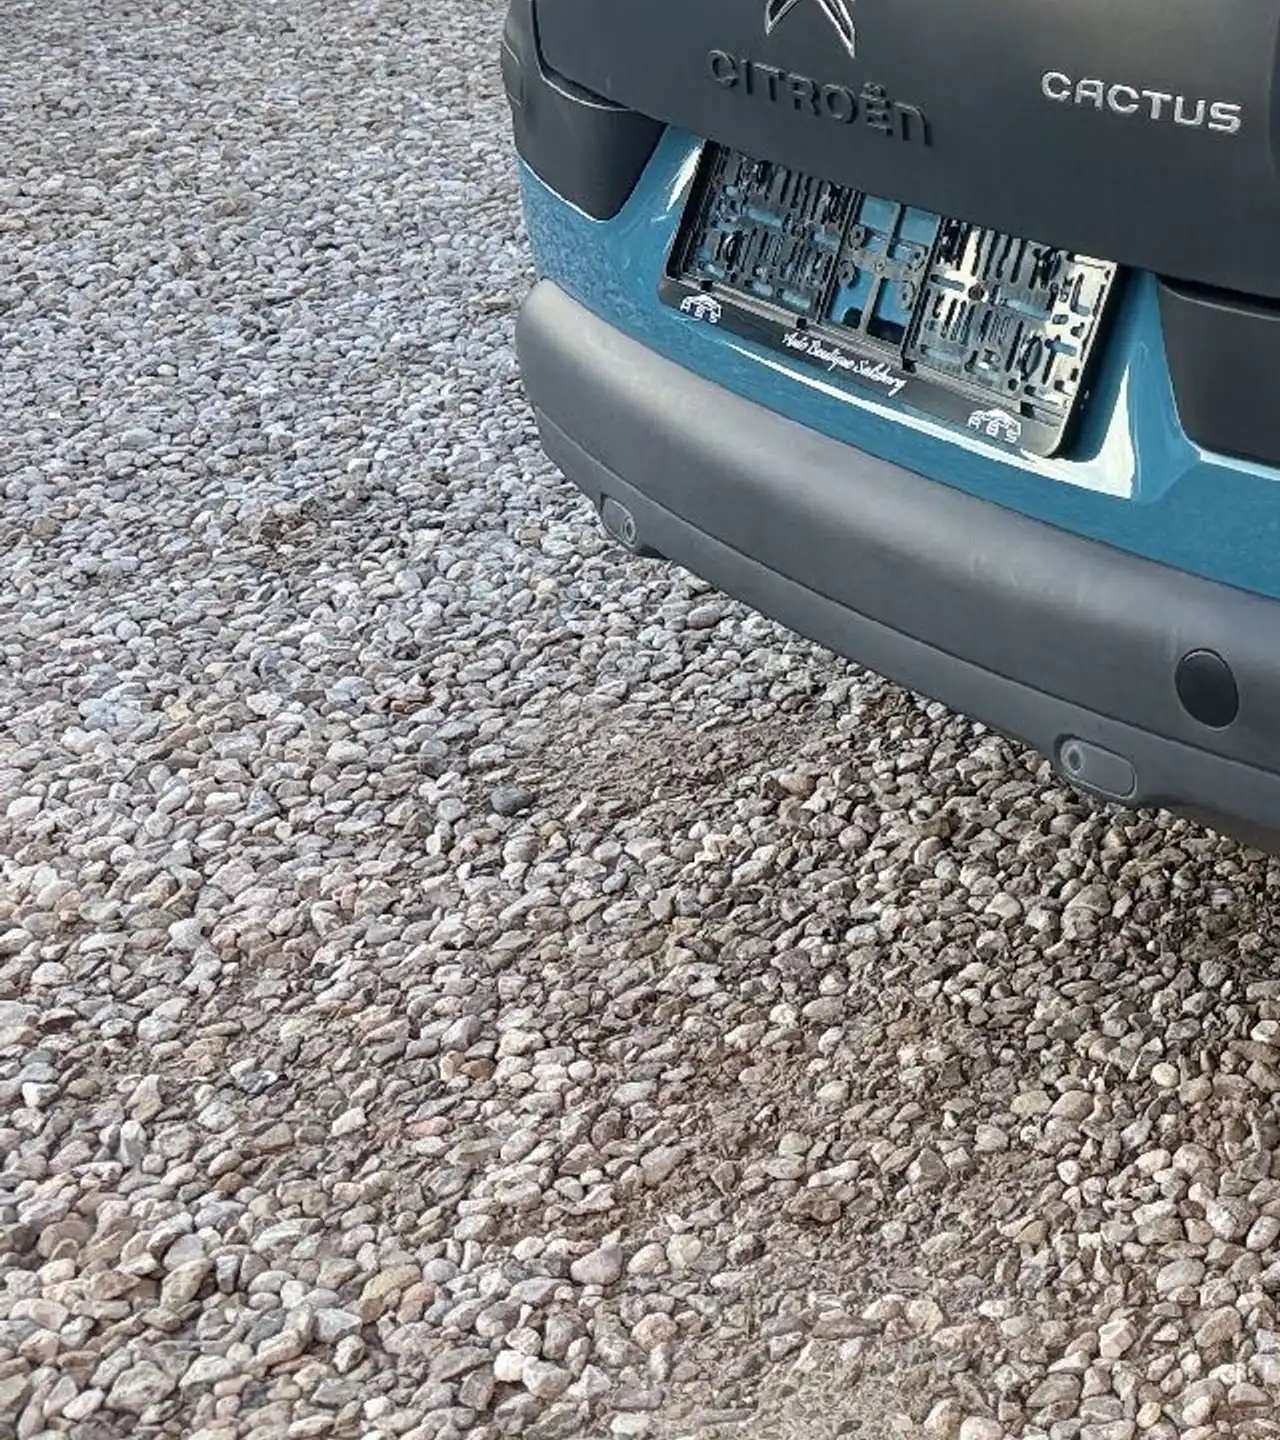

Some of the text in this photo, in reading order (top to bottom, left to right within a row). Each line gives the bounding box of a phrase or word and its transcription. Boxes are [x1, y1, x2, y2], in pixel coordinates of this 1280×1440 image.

[708, 49, 933, 147] CITROËN
[1041, 71, 1242, 135] CACTUS
[781, 331, 809, 351] Auto
